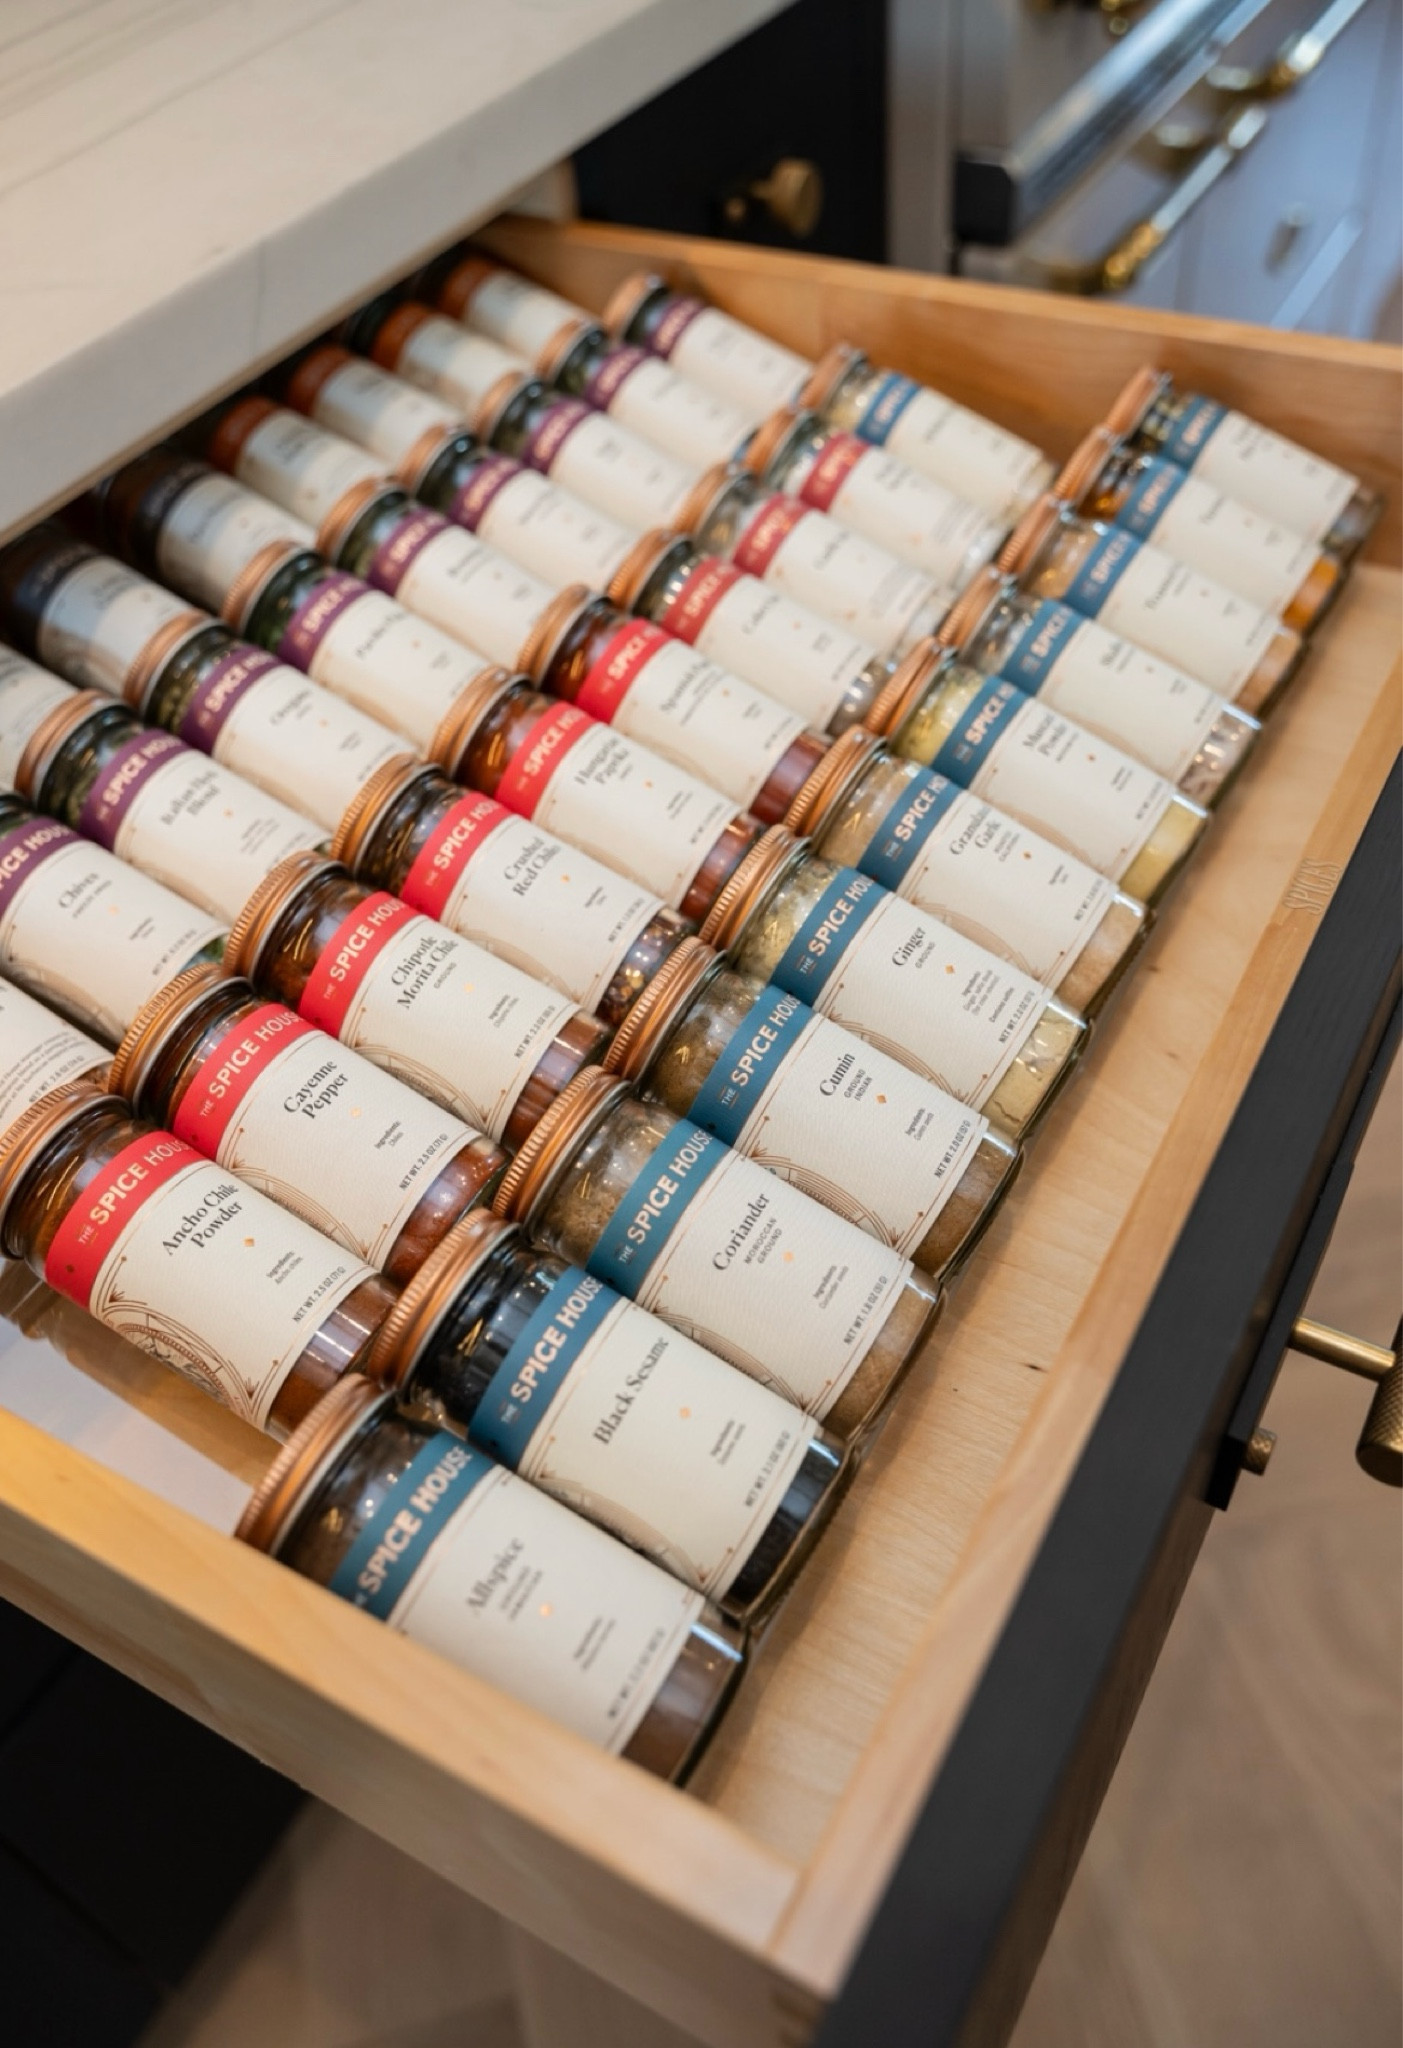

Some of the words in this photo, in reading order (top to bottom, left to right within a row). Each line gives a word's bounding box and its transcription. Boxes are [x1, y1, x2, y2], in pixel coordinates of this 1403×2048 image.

[607, 636, 648, 680] SPICE
[204, 663, 249, 712] SPICE
[965, 694, 1006, 745] SPICE
[523, 726, 564, 776] SPICE
[102, 753, 148, 806] SPICE
[894, 788, 936, 842] SPICE
[433, 817, 477, 870] SPICE
[512, 866, 538, 898] Red
[1283, 858, 1341, 915] SPICES
[330, 924, 375, 982] SPICE
[391, 936, 438, 986] Chipotle
[800, 957, 815, 974] THE
[808, 898, 855, 958] SPICE
[891, 926, 926, 967] Ginger
[915, 941, 936, 969] GROUND
[397, 962, 436, 1009] Morita
[998, 1029, 1011, 1044] NET
[200, 1100, 214, 1116] THE
[209, 1039, 260, 1098] SPICE
[283, 1061, 338, 1114] Cayenne
[721, 1088, 737, 1106] THE
[731, 1024, 779, 1087] SPICE
[819, 1053, 856, 1097] Cumin
[843, 1068, 867, 1099] GROUND
[854, 1076, 873, 1102] INDIAN
[301, 1073, 348, 1119] Pepper
[78, 1225, 95, 1244] THE
[89, 1163, 150, 1225] SPICE
[143, 1140, 195, 1167] HOUS
[399, 1174, 410, 1191] NET
[933, 1162, 947, 1179] NET
[162, 1207, 208, 1256] Ancho
[203, 1183, 240, 1207] Chile
[190, 1201, 243, 1249] Powder
[618, 1245, 634, 1264] THE
[627, 1174, 679, 1245] SPICE
[712, 1193, 770, 1271] Coriander
[744, 1217, 777, 1265] MOROCCAN
[757, 1228, 783, 1265] GROUND
[292, 1306, 307, 1323] NET
[843, 1327, 857, 1345] NET
[510, 1325, 567, 1403] SPICE
[593, 1392, 636, 1445] Black
[626, 1336, 670, 1392] Sesame
[357, 1509, 423, 1595] SPICE
[466, 1538, 525, 1616] Allspice
